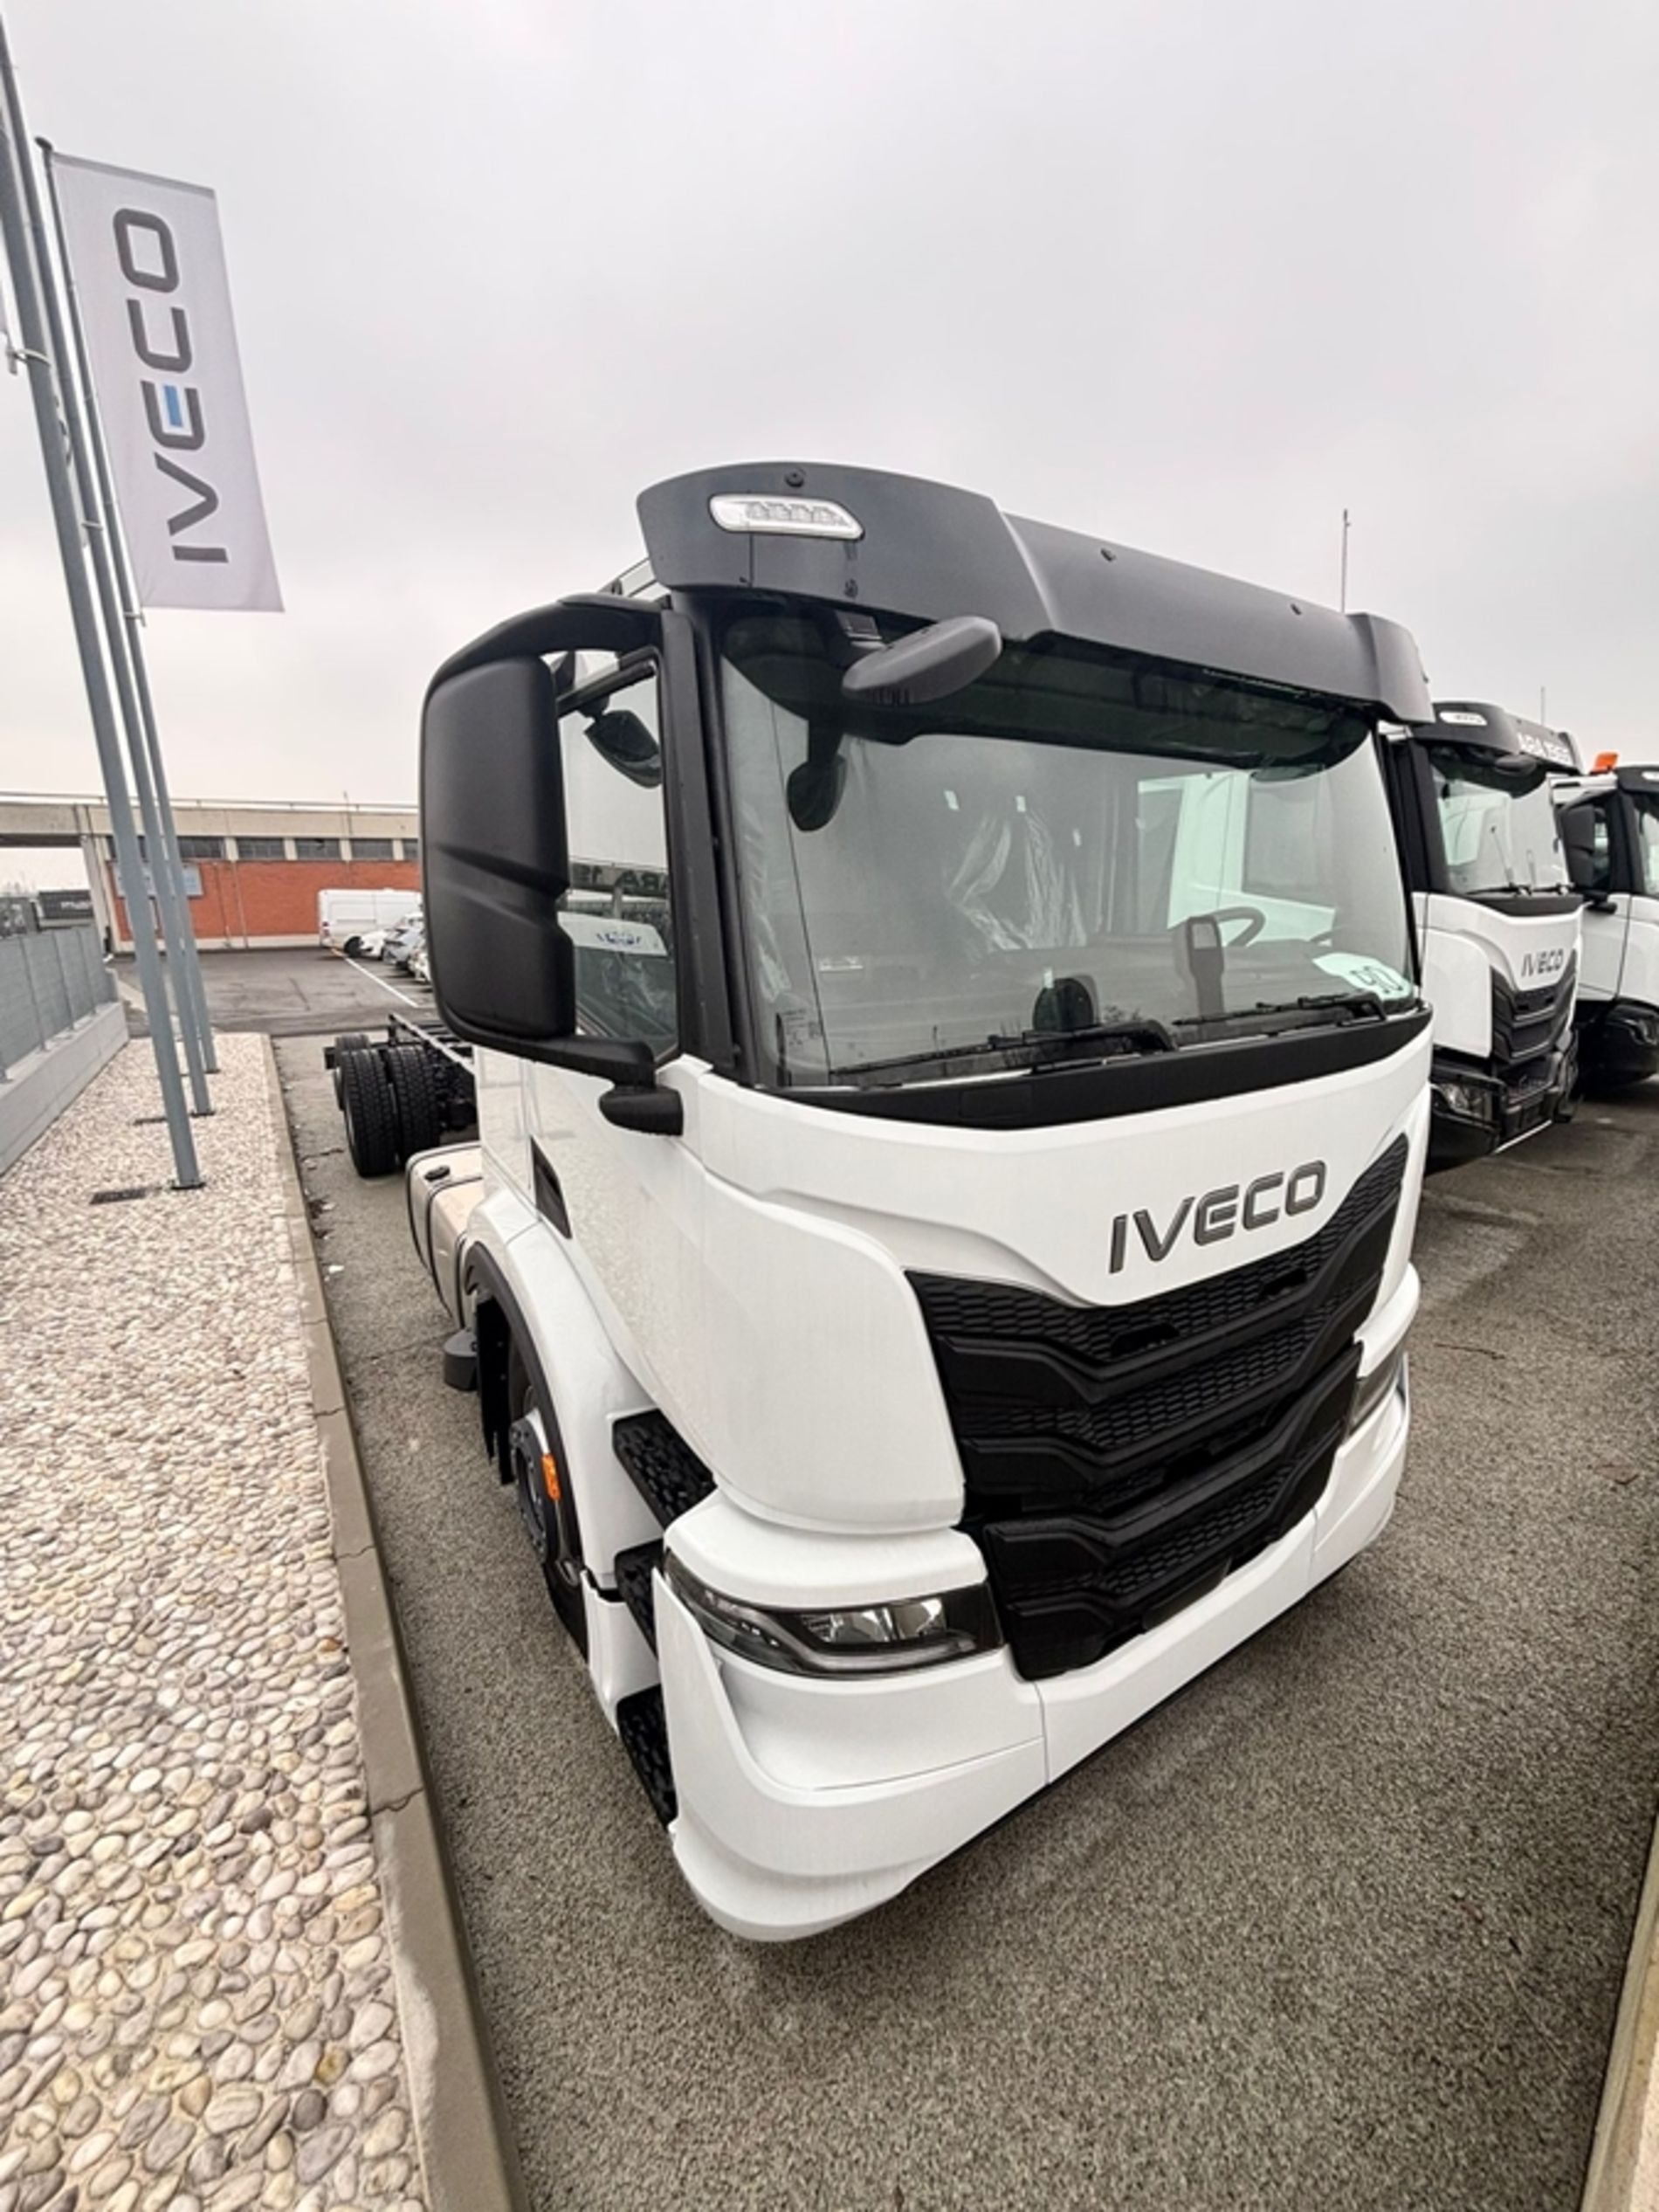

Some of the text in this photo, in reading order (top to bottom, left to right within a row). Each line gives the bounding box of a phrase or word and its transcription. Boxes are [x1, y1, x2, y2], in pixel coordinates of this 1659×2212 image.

[112, 208, 229, 563] IVECO
[1521, 948, 1564, 976] IVECO
[1108, 1160, 1325, 1274] IVECO
